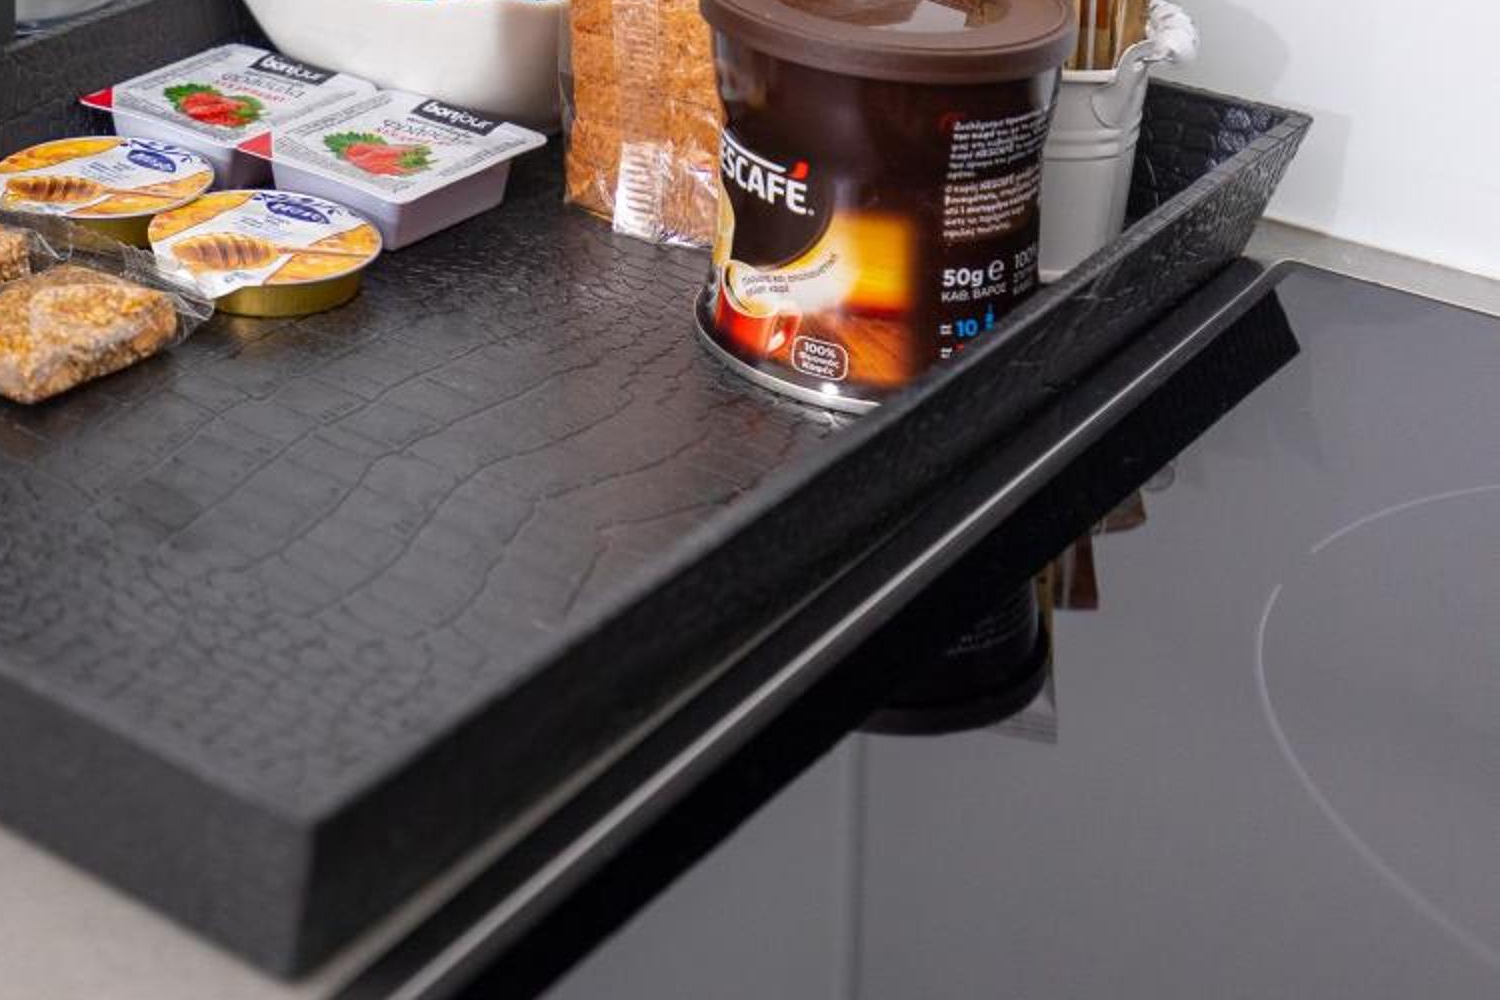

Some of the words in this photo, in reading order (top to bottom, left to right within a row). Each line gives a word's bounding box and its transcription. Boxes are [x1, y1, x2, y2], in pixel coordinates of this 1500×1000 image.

[259, 54, 325, 81] bonjour
[421, 100, 495, 130] bonjour
[943, 267, 984, 287] 50g
[955, 318, 979, 337] 10
[803, 341, 837, 359] 100%
